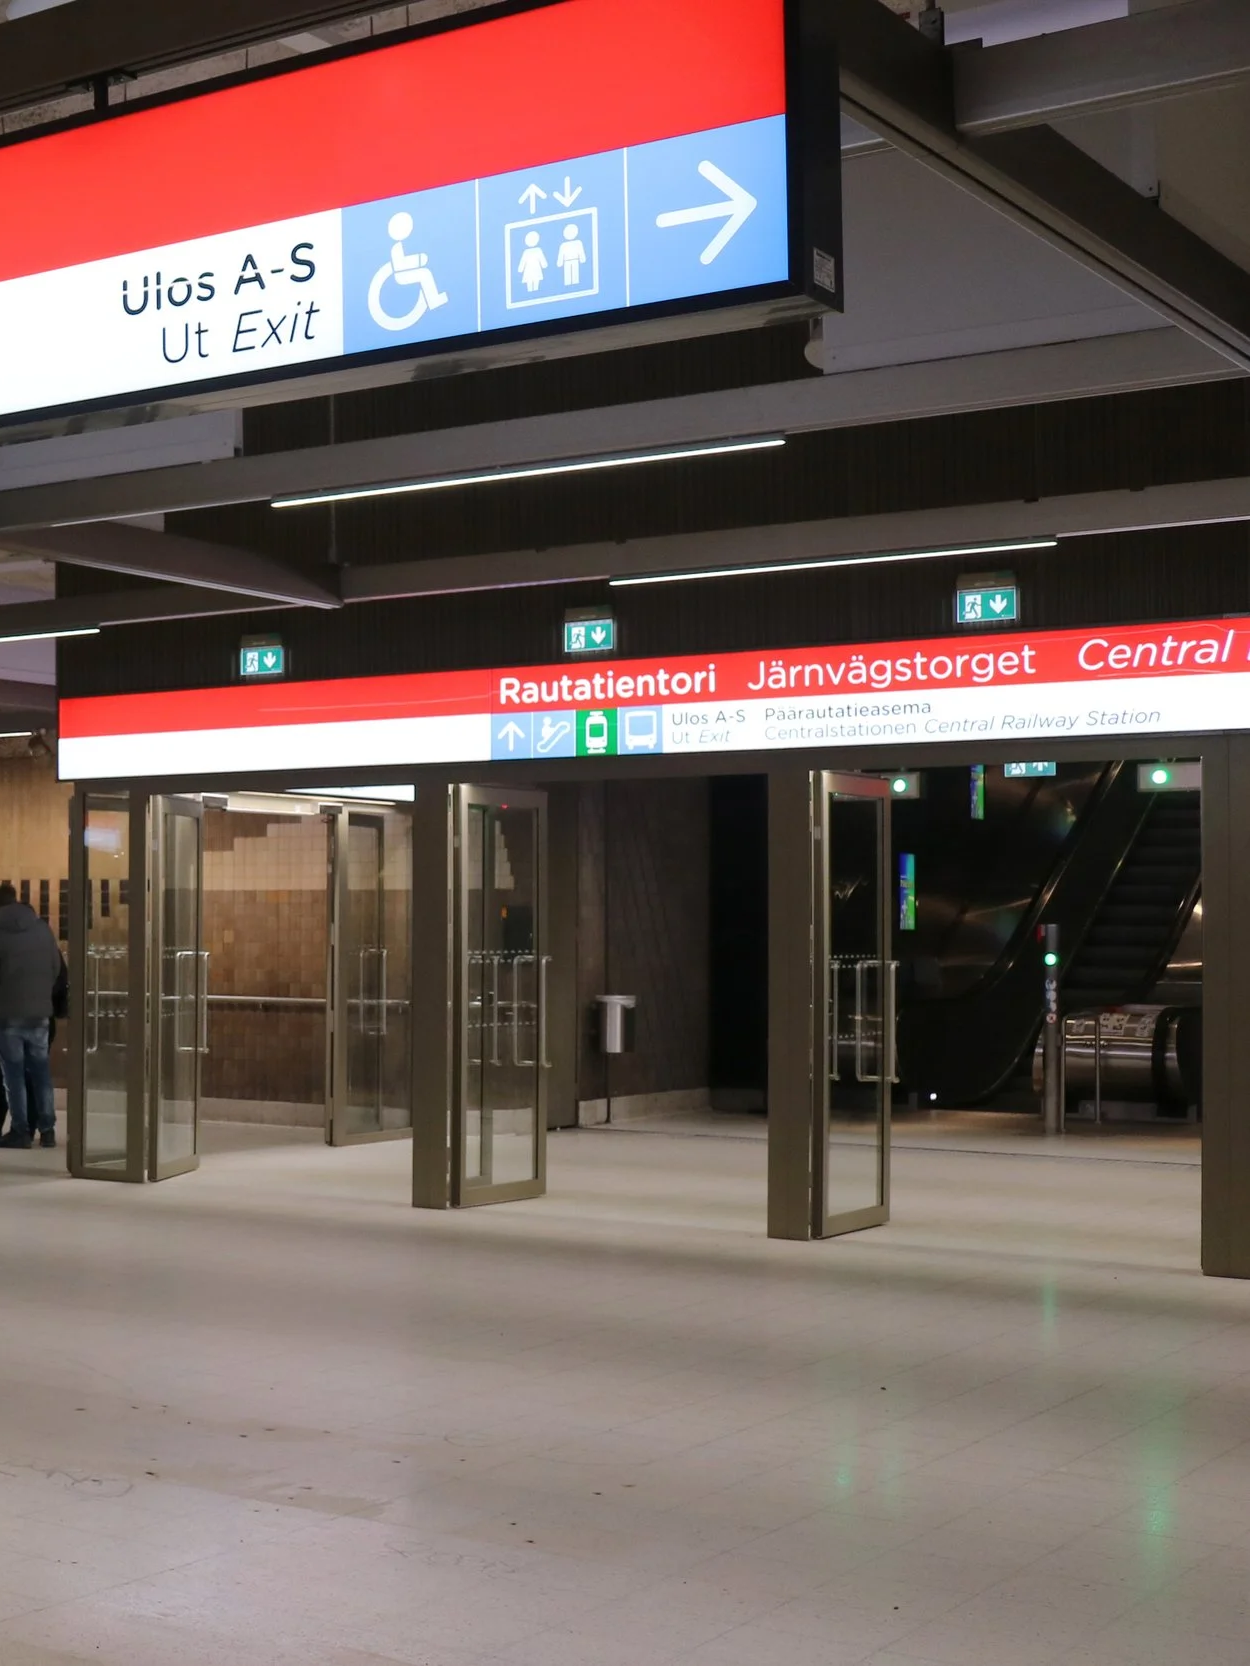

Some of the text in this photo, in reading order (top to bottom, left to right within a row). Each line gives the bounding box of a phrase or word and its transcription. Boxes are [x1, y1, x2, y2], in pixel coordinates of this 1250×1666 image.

[122, 242, 316, 316] Ulos A-S
[162, 300, 321, 364] Ut Exit
[499, 663, 716, 705] Rautatientori
[747, 644, 1036, 692] Järnvägstorget
[1078, 629, 1236, 671] Central
[671, 702, 932, 726] Ulos A-S Päärautatieasema
[671, 708, 1161, 745] Ut Exit Centralstationen Central Railway Station
